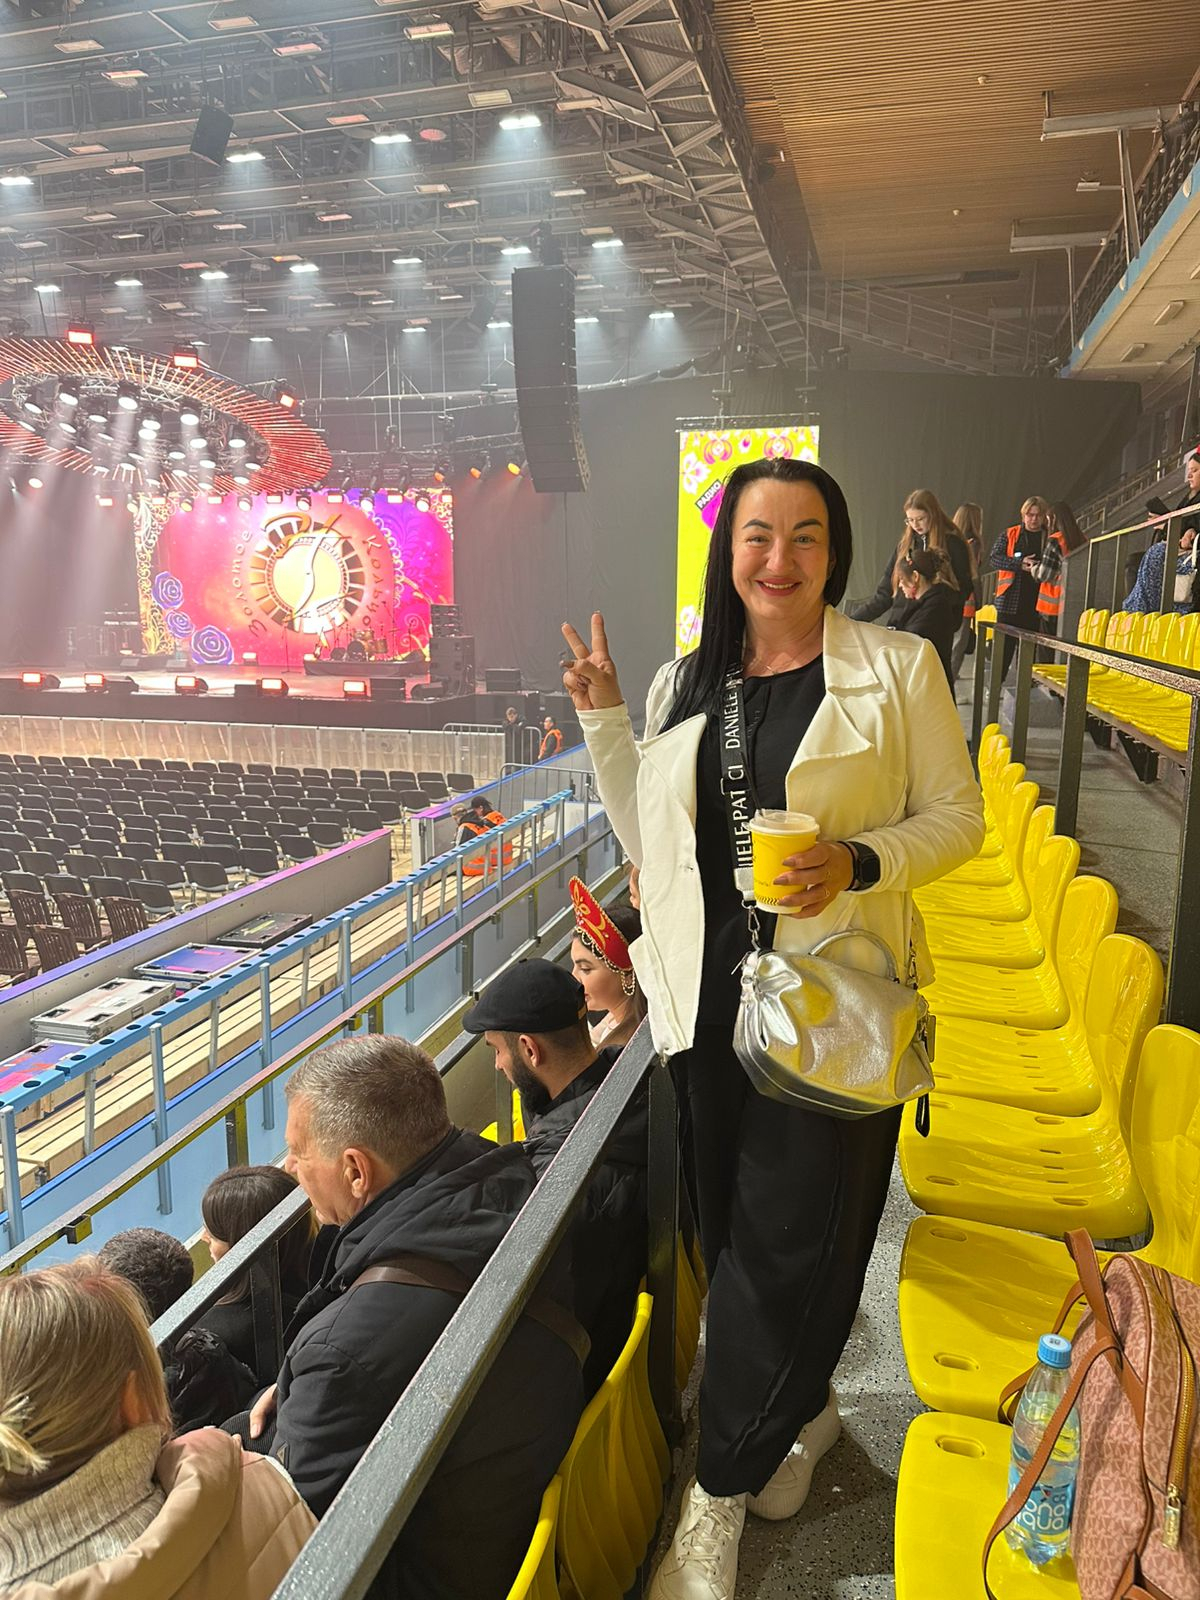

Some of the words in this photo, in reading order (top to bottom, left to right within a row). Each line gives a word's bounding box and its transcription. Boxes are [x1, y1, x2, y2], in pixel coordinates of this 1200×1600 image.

[696, 480, 721, 509] РАДИО
[724, 691, 741, 750] DANIELE
[1024, 1498, 1066, 1517] ona
